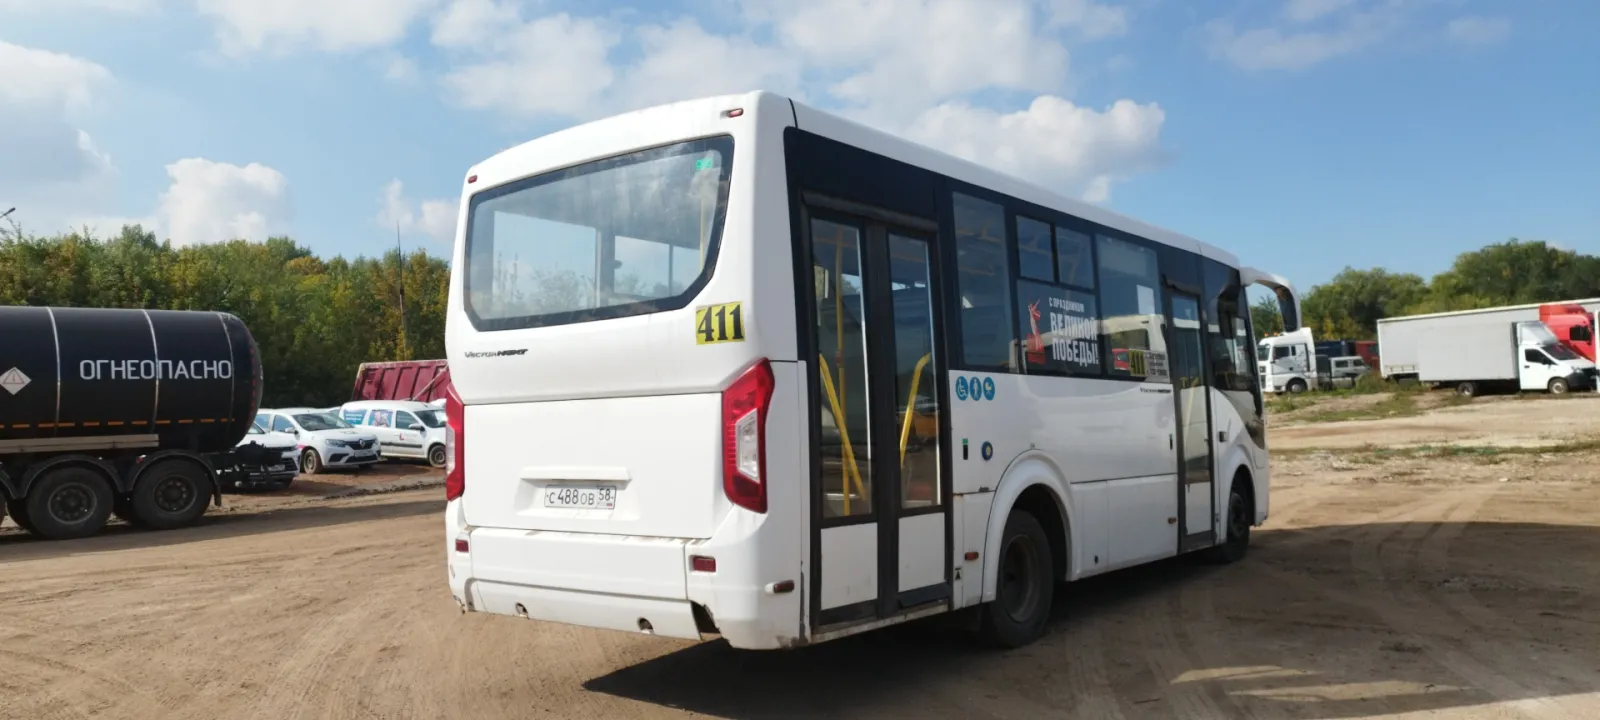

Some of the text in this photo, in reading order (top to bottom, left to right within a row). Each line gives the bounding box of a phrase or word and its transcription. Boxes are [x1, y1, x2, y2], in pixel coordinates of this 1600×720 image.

[697, 303, 744, 342] 411
[1050, 311, 1098, 341] ВЕЛИКОЙ
[1052, 337, 1099, 368] ПОБЕДЫ!
[79, 359, 232, 380] ОГНЕОПАСНО
